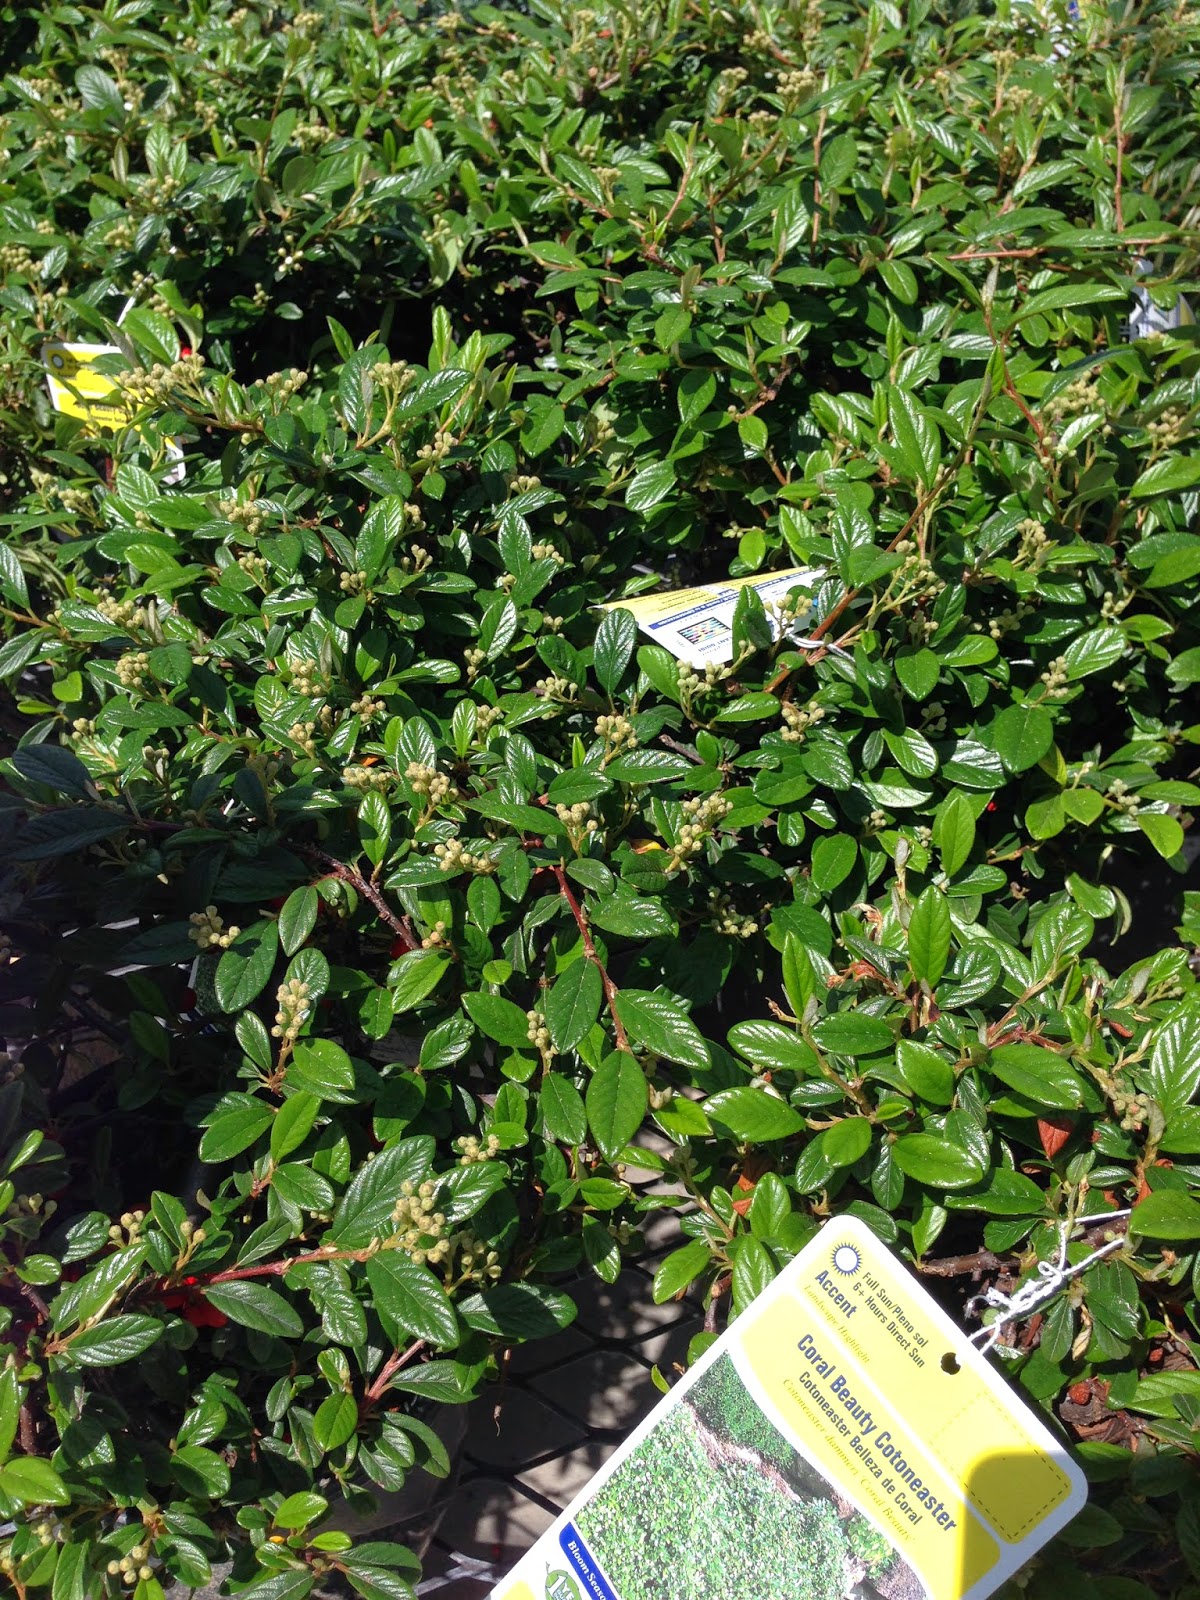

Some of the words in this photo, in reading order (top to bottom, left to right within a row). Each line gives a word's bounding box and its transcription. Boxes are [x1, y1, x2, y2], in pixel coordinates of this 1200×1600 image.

[804, 1285, 839, 1325] Landscape
[837, 1325, 870, 1363] Highlight
[814, 1269, 858, 1318] Accent
[852, 1282, 865, 1297] 6+
[864, 1295, 888, 1324] Hours
[886, 1320, 911, 1350] Direct
[908, 1347, 925, 1368] Sun
[862, 1272, 880, 1291] Full
[876, 1288, 914, 1334] Sun/Pleno
[913, 1332, 929, 1348] sol
[783, 1379, 827, 1433] Cotoneaster
[797, 1333, 836, 1380] Coral
[829, 1374, 878, 1436] Beauty
[874, 1431, 957, 1532] Cotoneaster
[799, 1371, 851, 1437] Cotoneaster
[849, 1435, 883, 1479] Belleza
[881, 1478, 896, 1495] de
[894, 1492, 923, 1526] Coral
[567, 1540, 589, 1574] Bloom
[586, 1572, 606, 1600] Seaso
